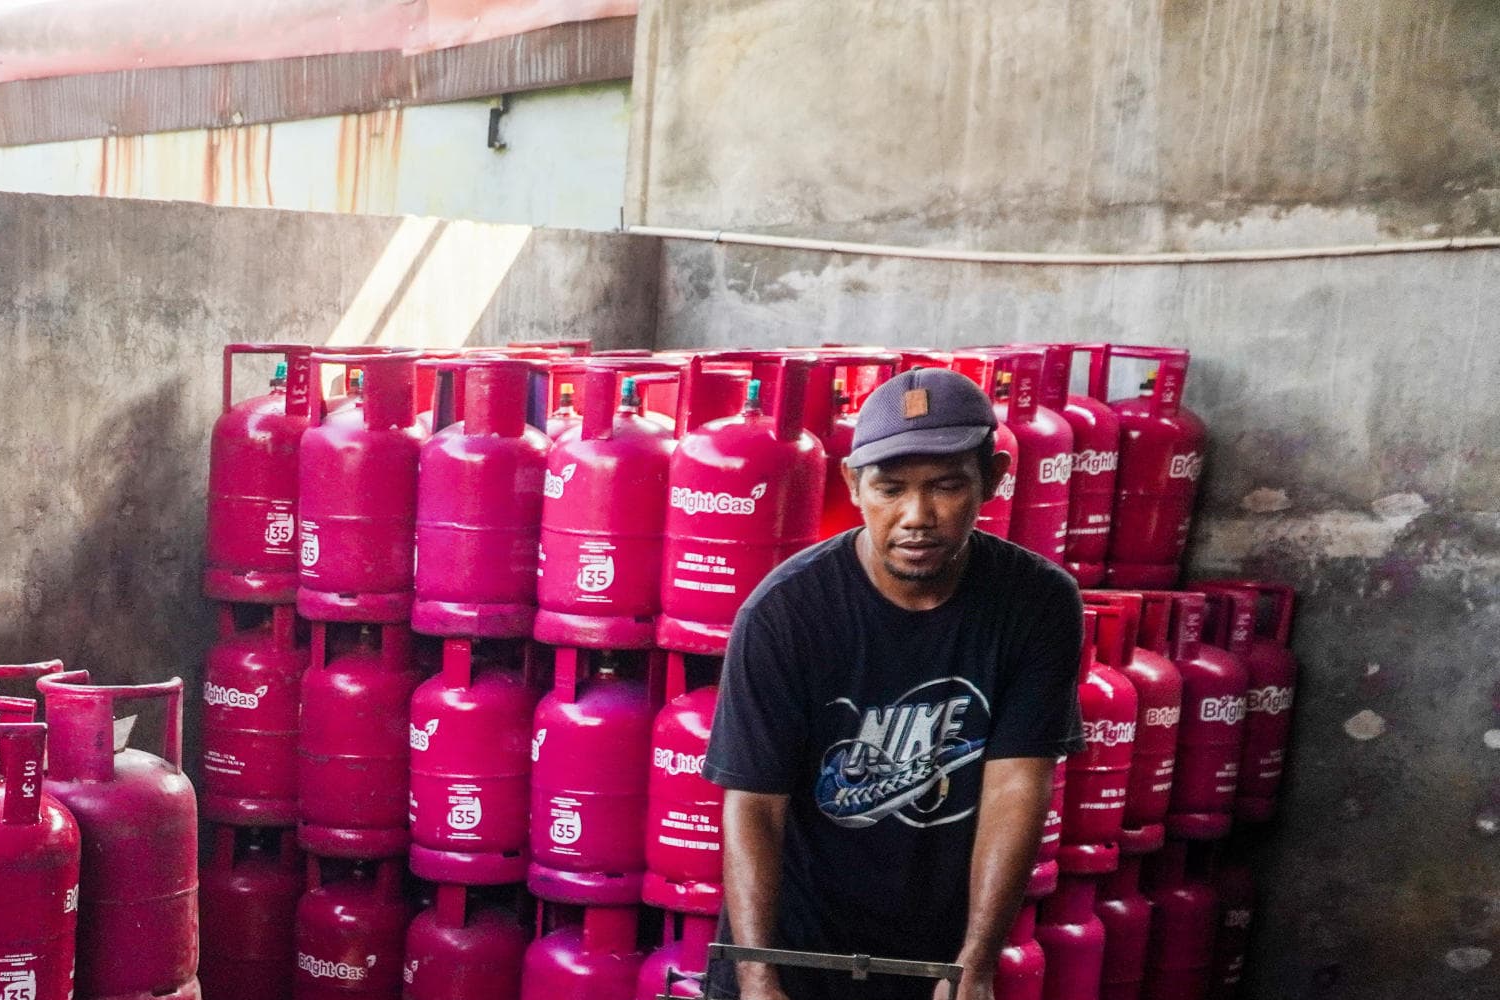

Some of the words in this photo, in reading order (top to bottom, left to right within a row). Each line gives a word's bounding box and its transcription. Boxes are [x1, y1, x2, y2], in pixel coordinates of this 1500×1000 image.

[669, 485, 715, 515] Bright
[714, 492, 756, 515] Gas
[266, 526, 290, 541] 135
[580, 569, 608, 587] 135
[226, 688, 259, 710] Gas
[849, 696, 972, 768] NIKE
[450, 809, 476, 824] 135
[552, 823, 576, 839] 135
[335, 962, 368, 981] Gas
